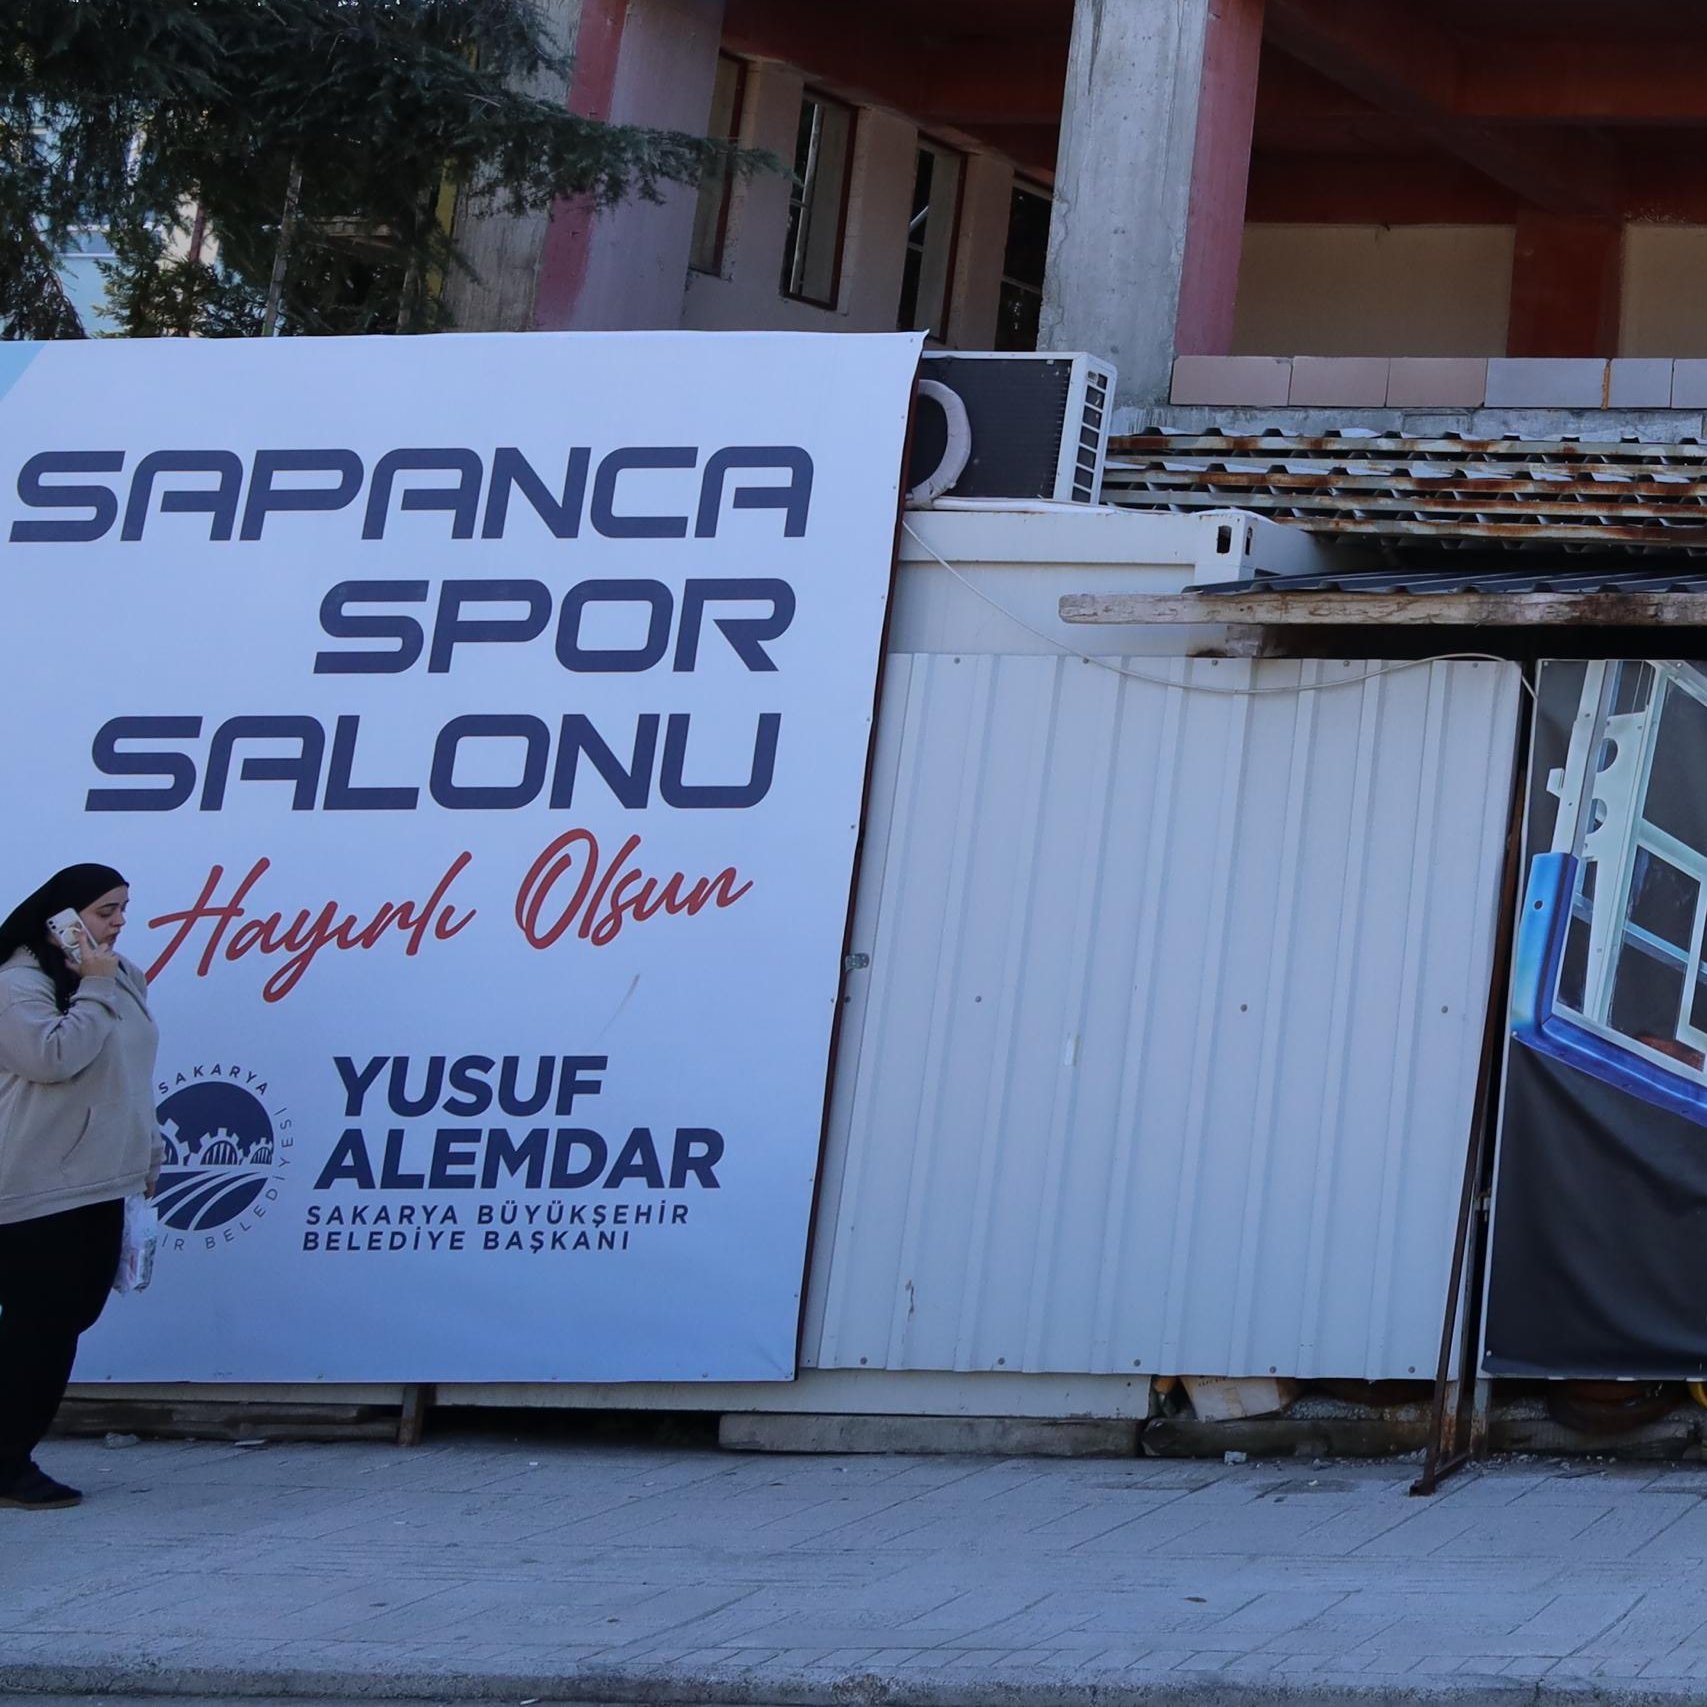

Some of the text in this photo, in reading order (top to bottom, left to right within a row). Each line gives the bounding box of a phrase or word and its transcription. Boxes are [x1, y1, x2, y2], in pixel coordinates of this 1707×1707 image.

[9, 446, 813, 542] SAPANCA
[314, 578, 795, 674] SPOR
[85, 713, 781, 811] SALONU
[148, 829, 753, 1003] Hayırlı Olsun
[158, 1063, 268, 1095] SAKARYA
[333, 1055, 608, 1117] YUSUF
[313, 1128, 724, 1189] ALEMDAR
[303, 1227, 629, 1256] BELEDİYE BAŞKANI
[306, 1199, 689, 1229] SAKARYA BÜYÜKŞEHİR
